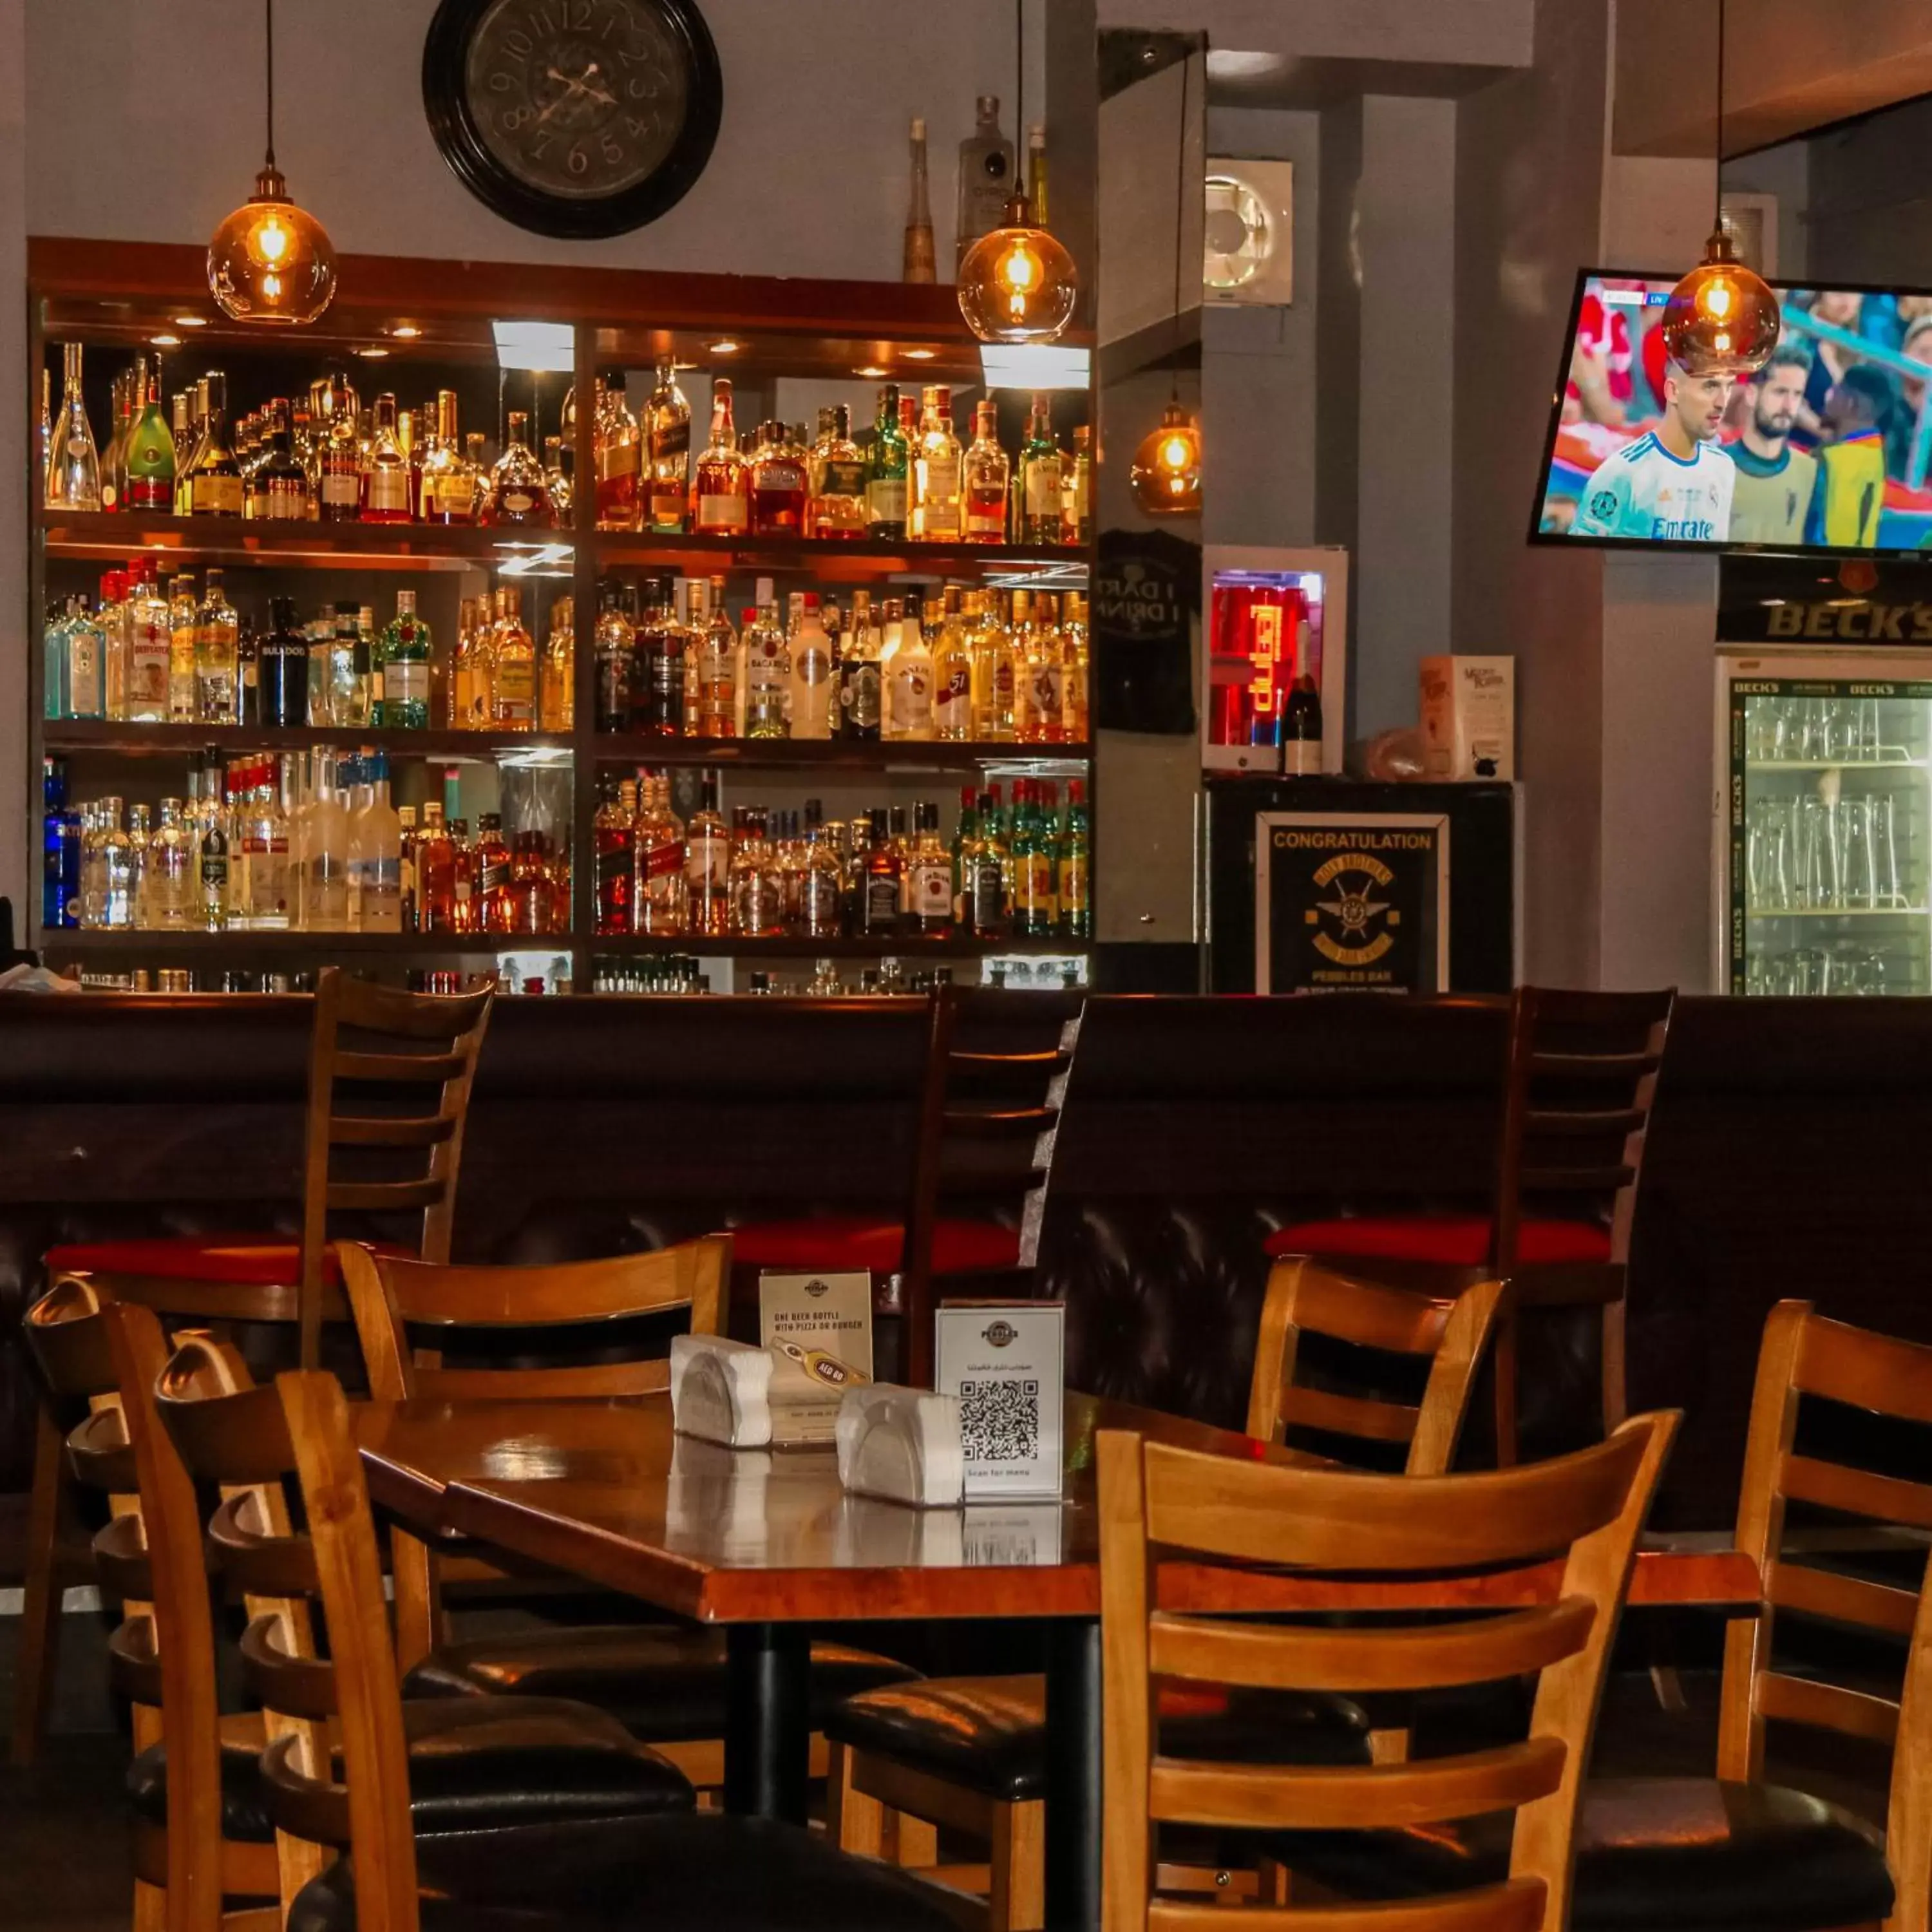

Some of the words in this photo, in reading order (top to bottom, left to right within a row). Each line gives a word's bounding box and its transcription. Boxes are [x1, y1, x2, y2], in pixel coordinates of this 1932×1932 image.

[529, 6, 556, 38] 11
[562, 0, 592, 30] 12
[601, 15, 616, 39] 1
[500, 30, 533, 62] 10
[489, 72, 520, 91] 9
[629, 78, 659, 99] 3
[503, 106, 530, 129] 8
[624, 116, 650, 138] 4
[530, 129, 553, 160] 7
[601, 134, 623, 164] 5
[568, 140, 588, 174] 6
[1274, 832, 1432, 849] CONGRATULATION
[774, 1312, 788, 1322] ONE
[791, 1312, 810, 1321] BEER
[813, 1311, 840, 1320] BOTTLE
[775, 1323, 793, 1332] WITH
[796, 1322, 817, 1331] PIZZA
[832, 1320, 863, 1330] BURGER
[818, 1362, 833, 1376] AED
